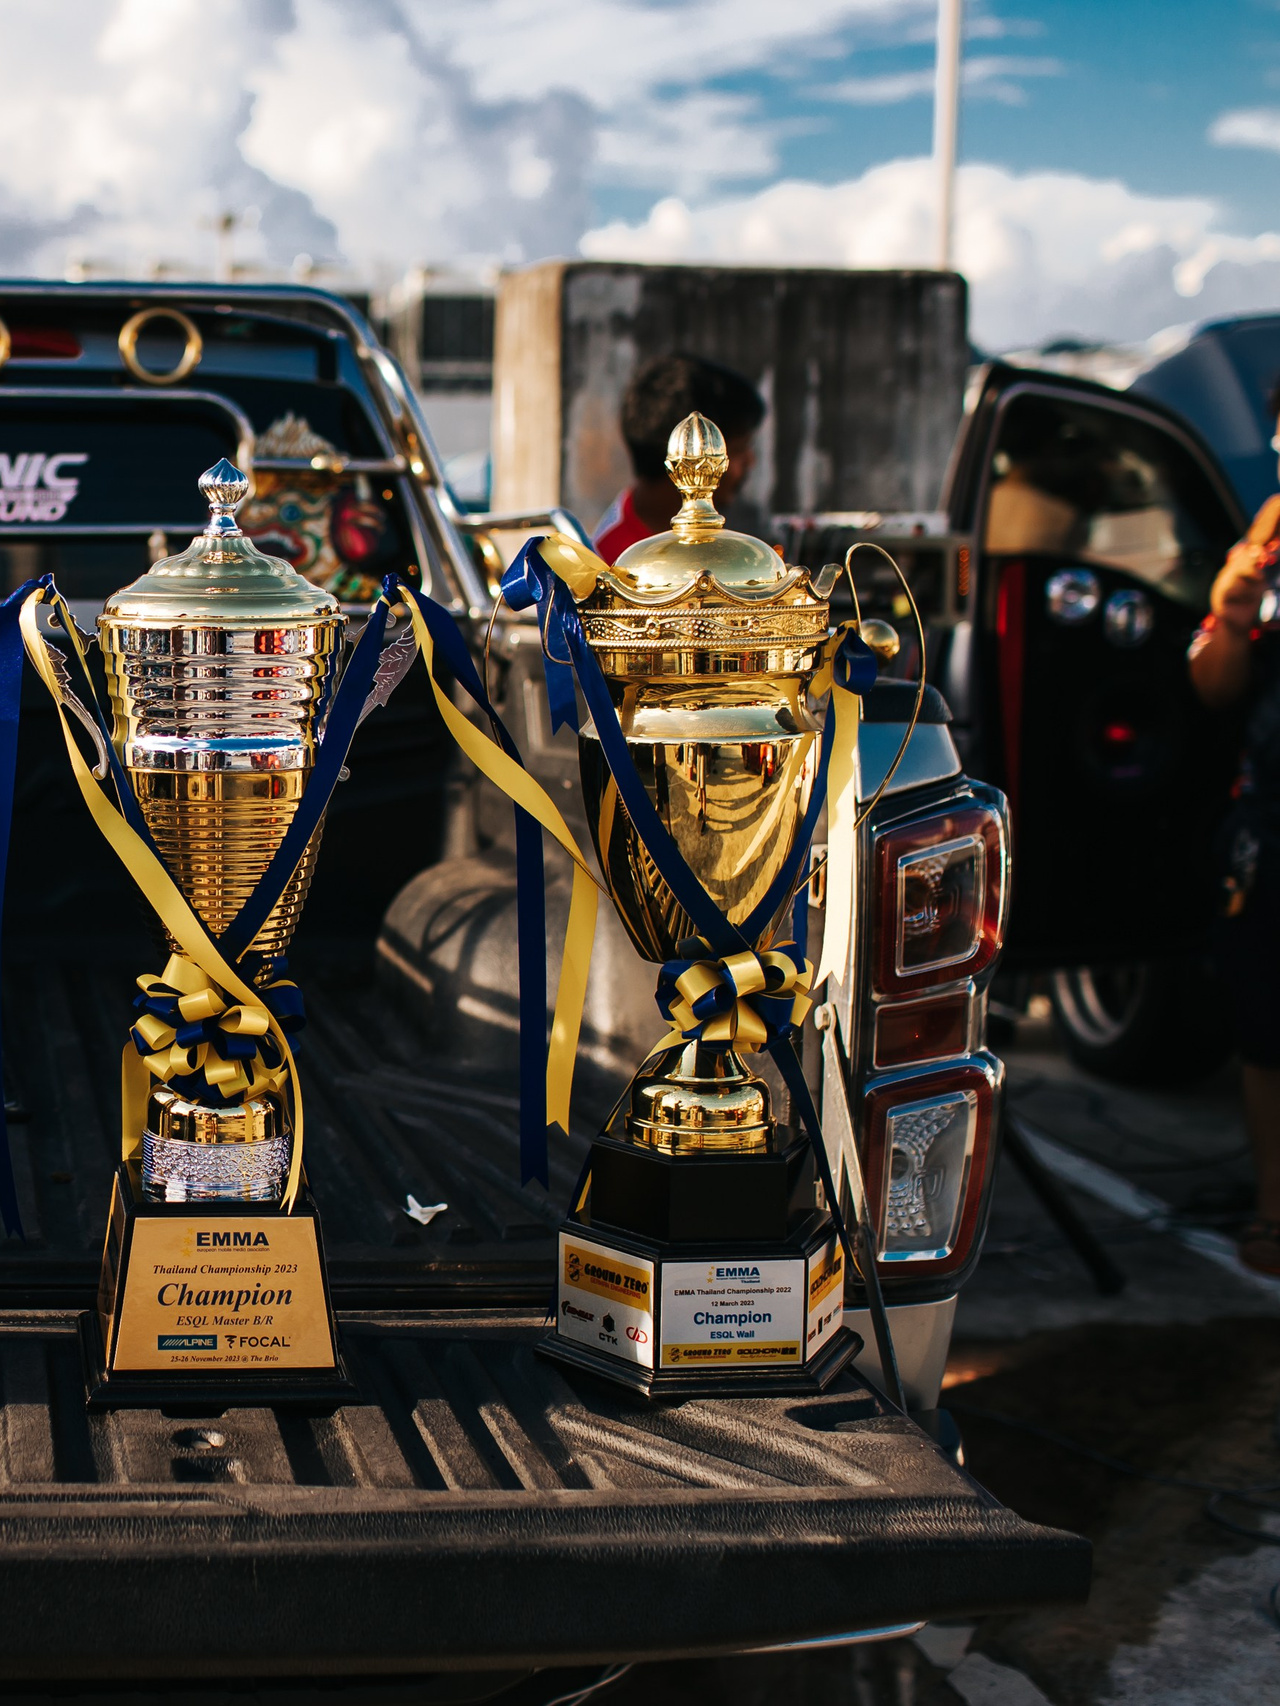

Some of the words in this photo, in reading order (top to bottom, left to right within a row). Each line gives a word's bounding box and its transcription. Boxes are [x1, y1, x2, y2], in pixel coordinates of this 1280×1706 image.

[196, 1232, 269, 1247] EMMA
[153, 1264, 198, 1274] Thailand
[200, 1264, 272, 1276] Championship
[274, 1264, 298, 1274] 2023
[716, 1267, 760, 1277] EMMA
[584, 1263, 622, 1286] GROUND
[623, 1276, 648, 1295] ZERO
[157, 1283, 293, 1312] Champion
[610, 1284, 641, 1300] ENGINEERING
[697, 1288, 726, 1296] Thailand
[726, 1287, 775, 1296] Championship
[176, 1316, 209, 1328] ESQL
[211, 1316, 250, 1326] Master
[252, 1315, 274, 1325] B/R
[693, 1311, 772, 1327] Champion
[599, 1332, 618, 1346] CTK
[710, 1331, 734, 1340] ESQL
[736, 1330, 755, 1338] Wall
[181, 1338, 214, 1347] ALPINE
[239, 1336, 290, 1348] FOCAL
[683, 1349, 712, 1357] GROUND
[713, 1348, 732, 1356] ZERO
[737, 1348, 781, 1356] GOLDHORN
[170, 1355, 189, 1363] 25-26
[190, 1355, 223, 1363] November
